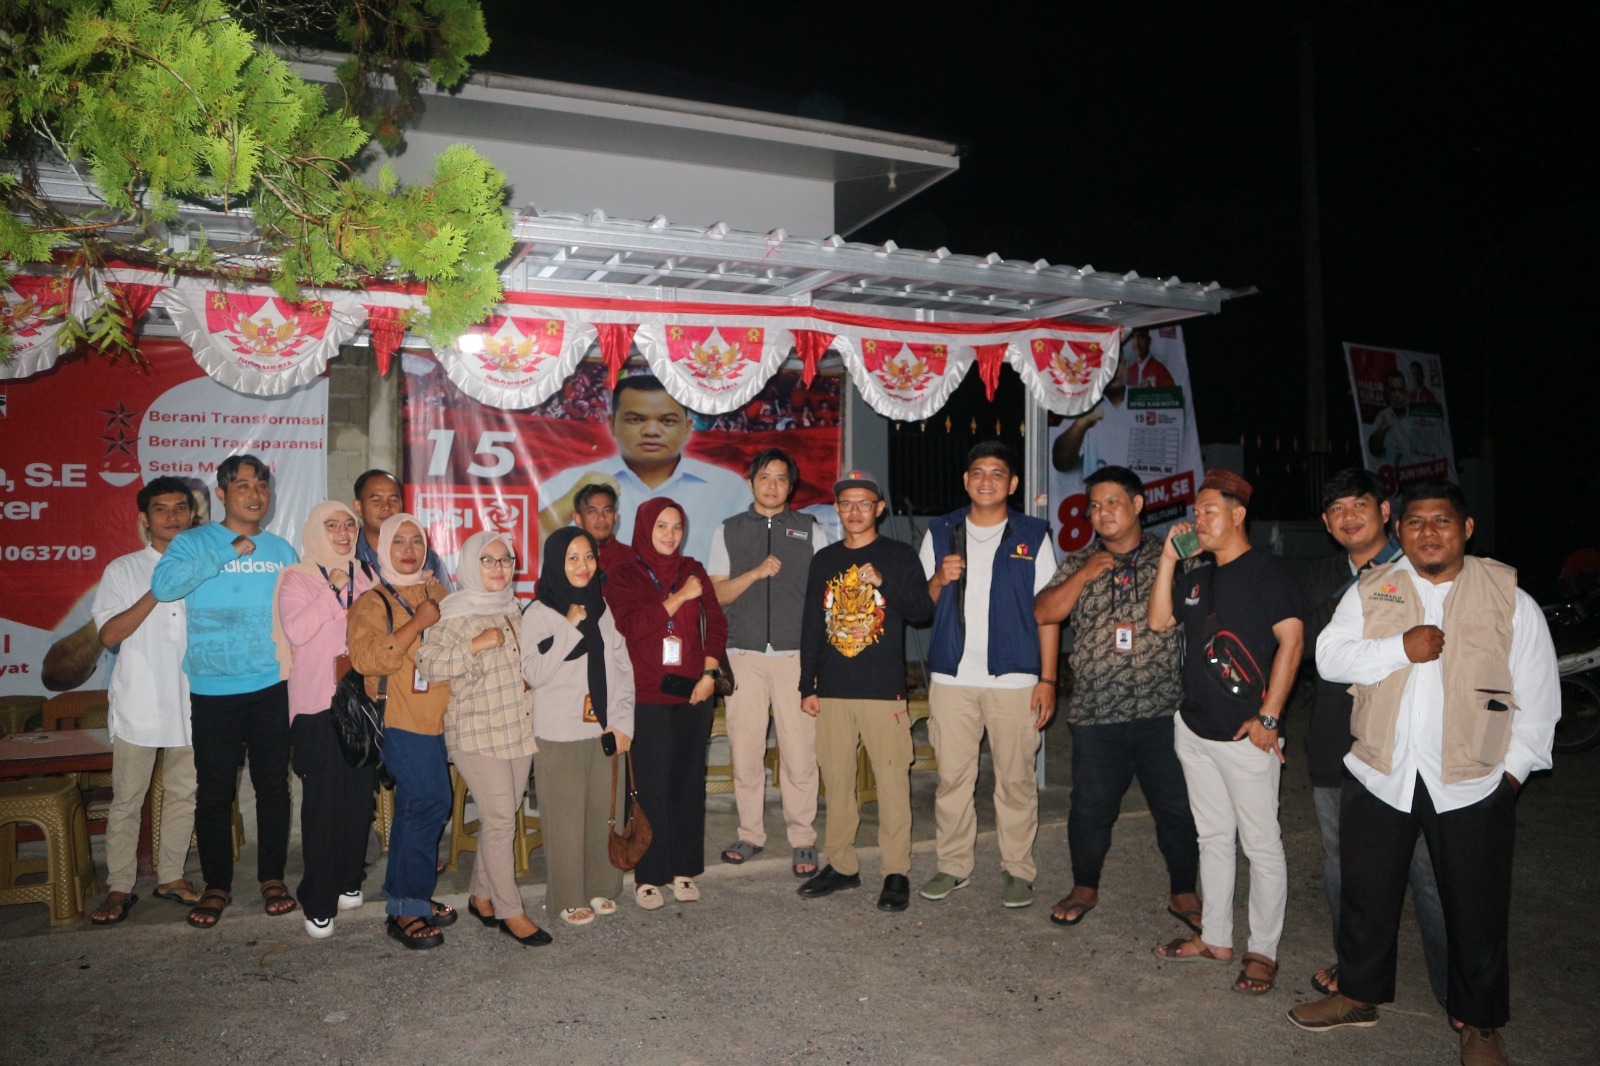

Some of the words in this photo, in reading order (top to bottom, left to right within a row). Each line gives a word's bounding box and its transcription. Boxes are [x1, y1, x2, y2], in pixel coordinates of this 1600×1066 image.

[149, 410, 206, 423] Berani
[211, 412, 325, 426] Transformasi
[1135, 414, 1145, 424] 15
[148, 435, 206, 448] Berani
[210, 436, 324, 452] Transparansi
[427, 428, 516, 477] 15
[25, 462, 87, 488] S.E
[148, 460, 194, 473] Setia
[1171, 478, 1190, 498] SE
[417, 508, 474, 529] PSI
[1058, 493, 1096, 552] 8
[224, 557, 276, 573] adidas
